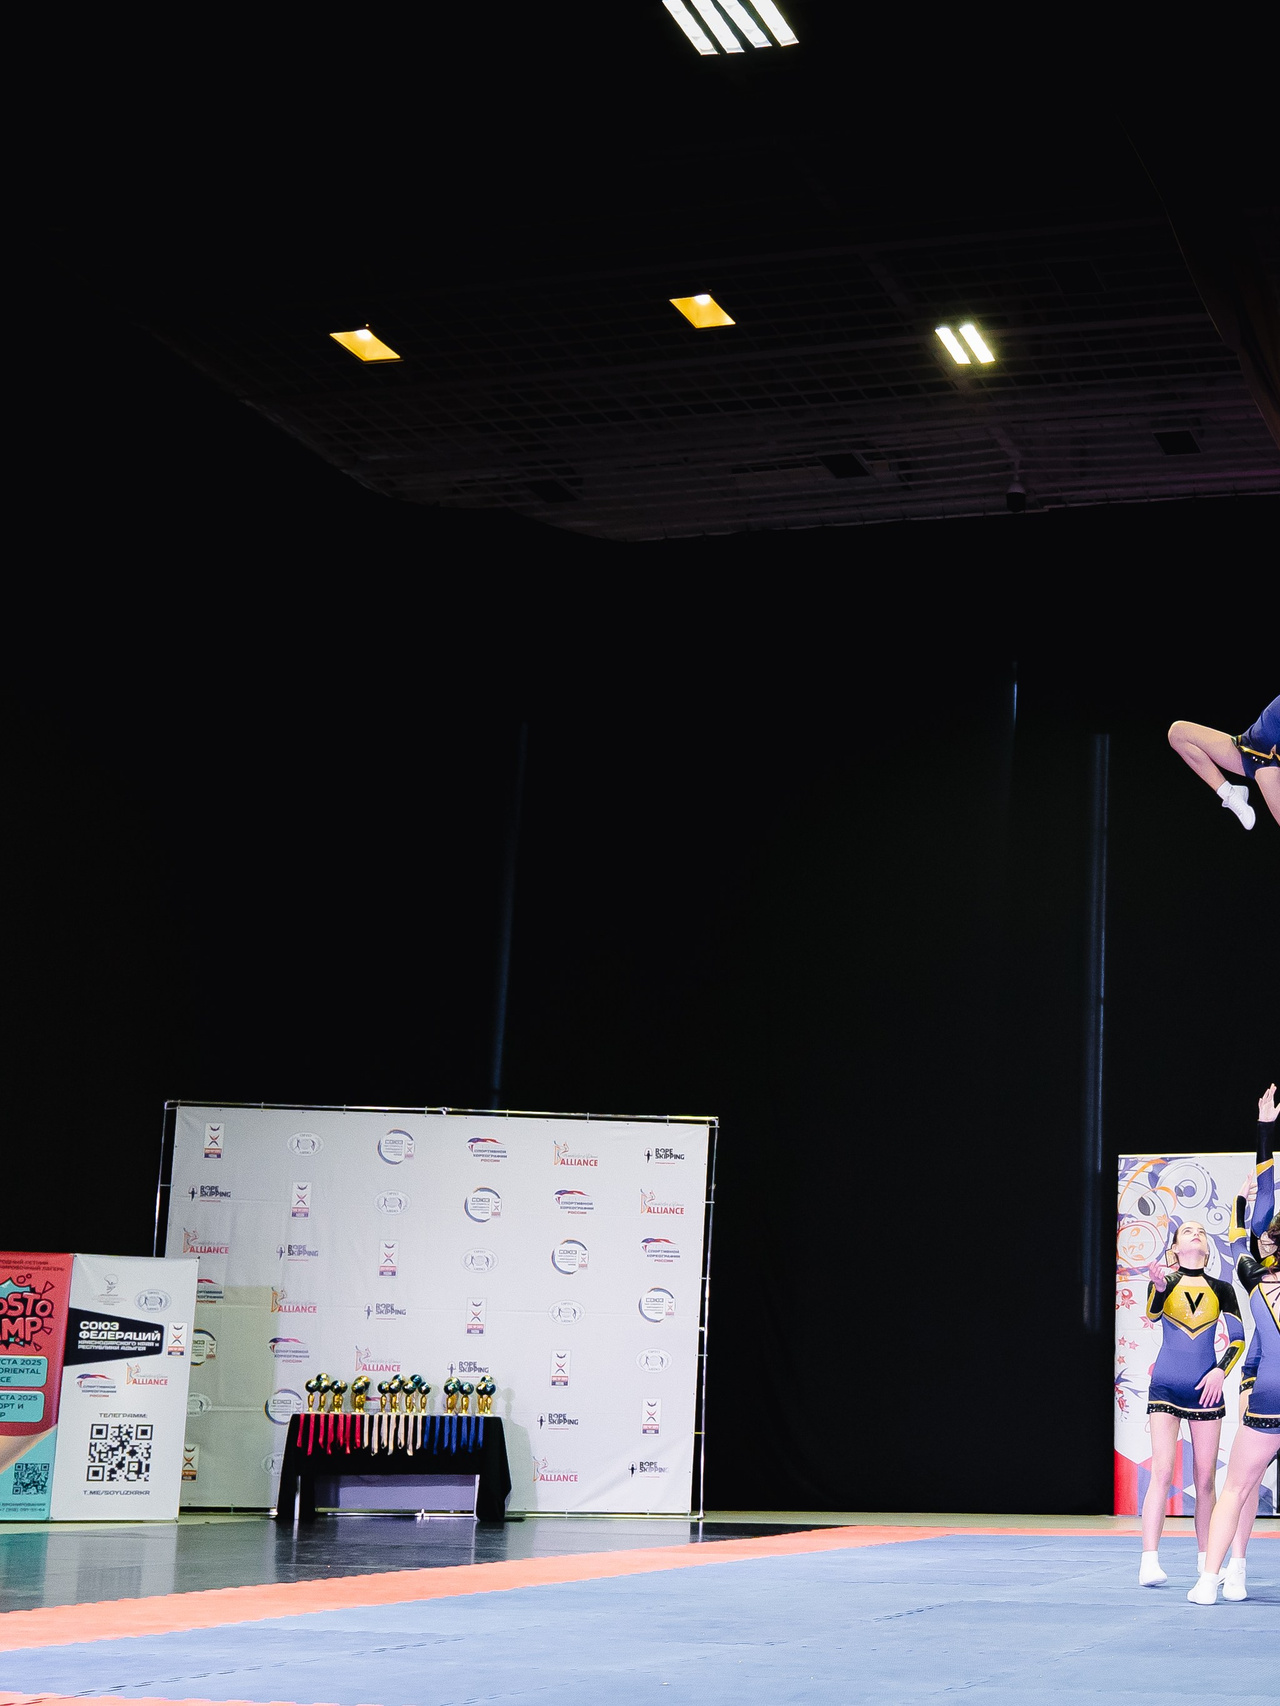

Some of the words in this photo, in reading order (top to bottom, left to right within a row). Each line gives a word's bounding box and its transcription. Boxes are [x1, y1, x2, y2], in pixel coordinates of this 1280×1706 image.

[189, 1246, 229, 1254] ALLIANCE
[1184, 1292, 1204, 1314] V
[80, 1321, 119, 1330] СОЮЗ
[79, 1331, 160, 1341] ФЕДЕРАЦИЙ
[362, 1364, 400, 1372] ALLIANCE
[540, 1474, 578, 1482] ALLIANCE
